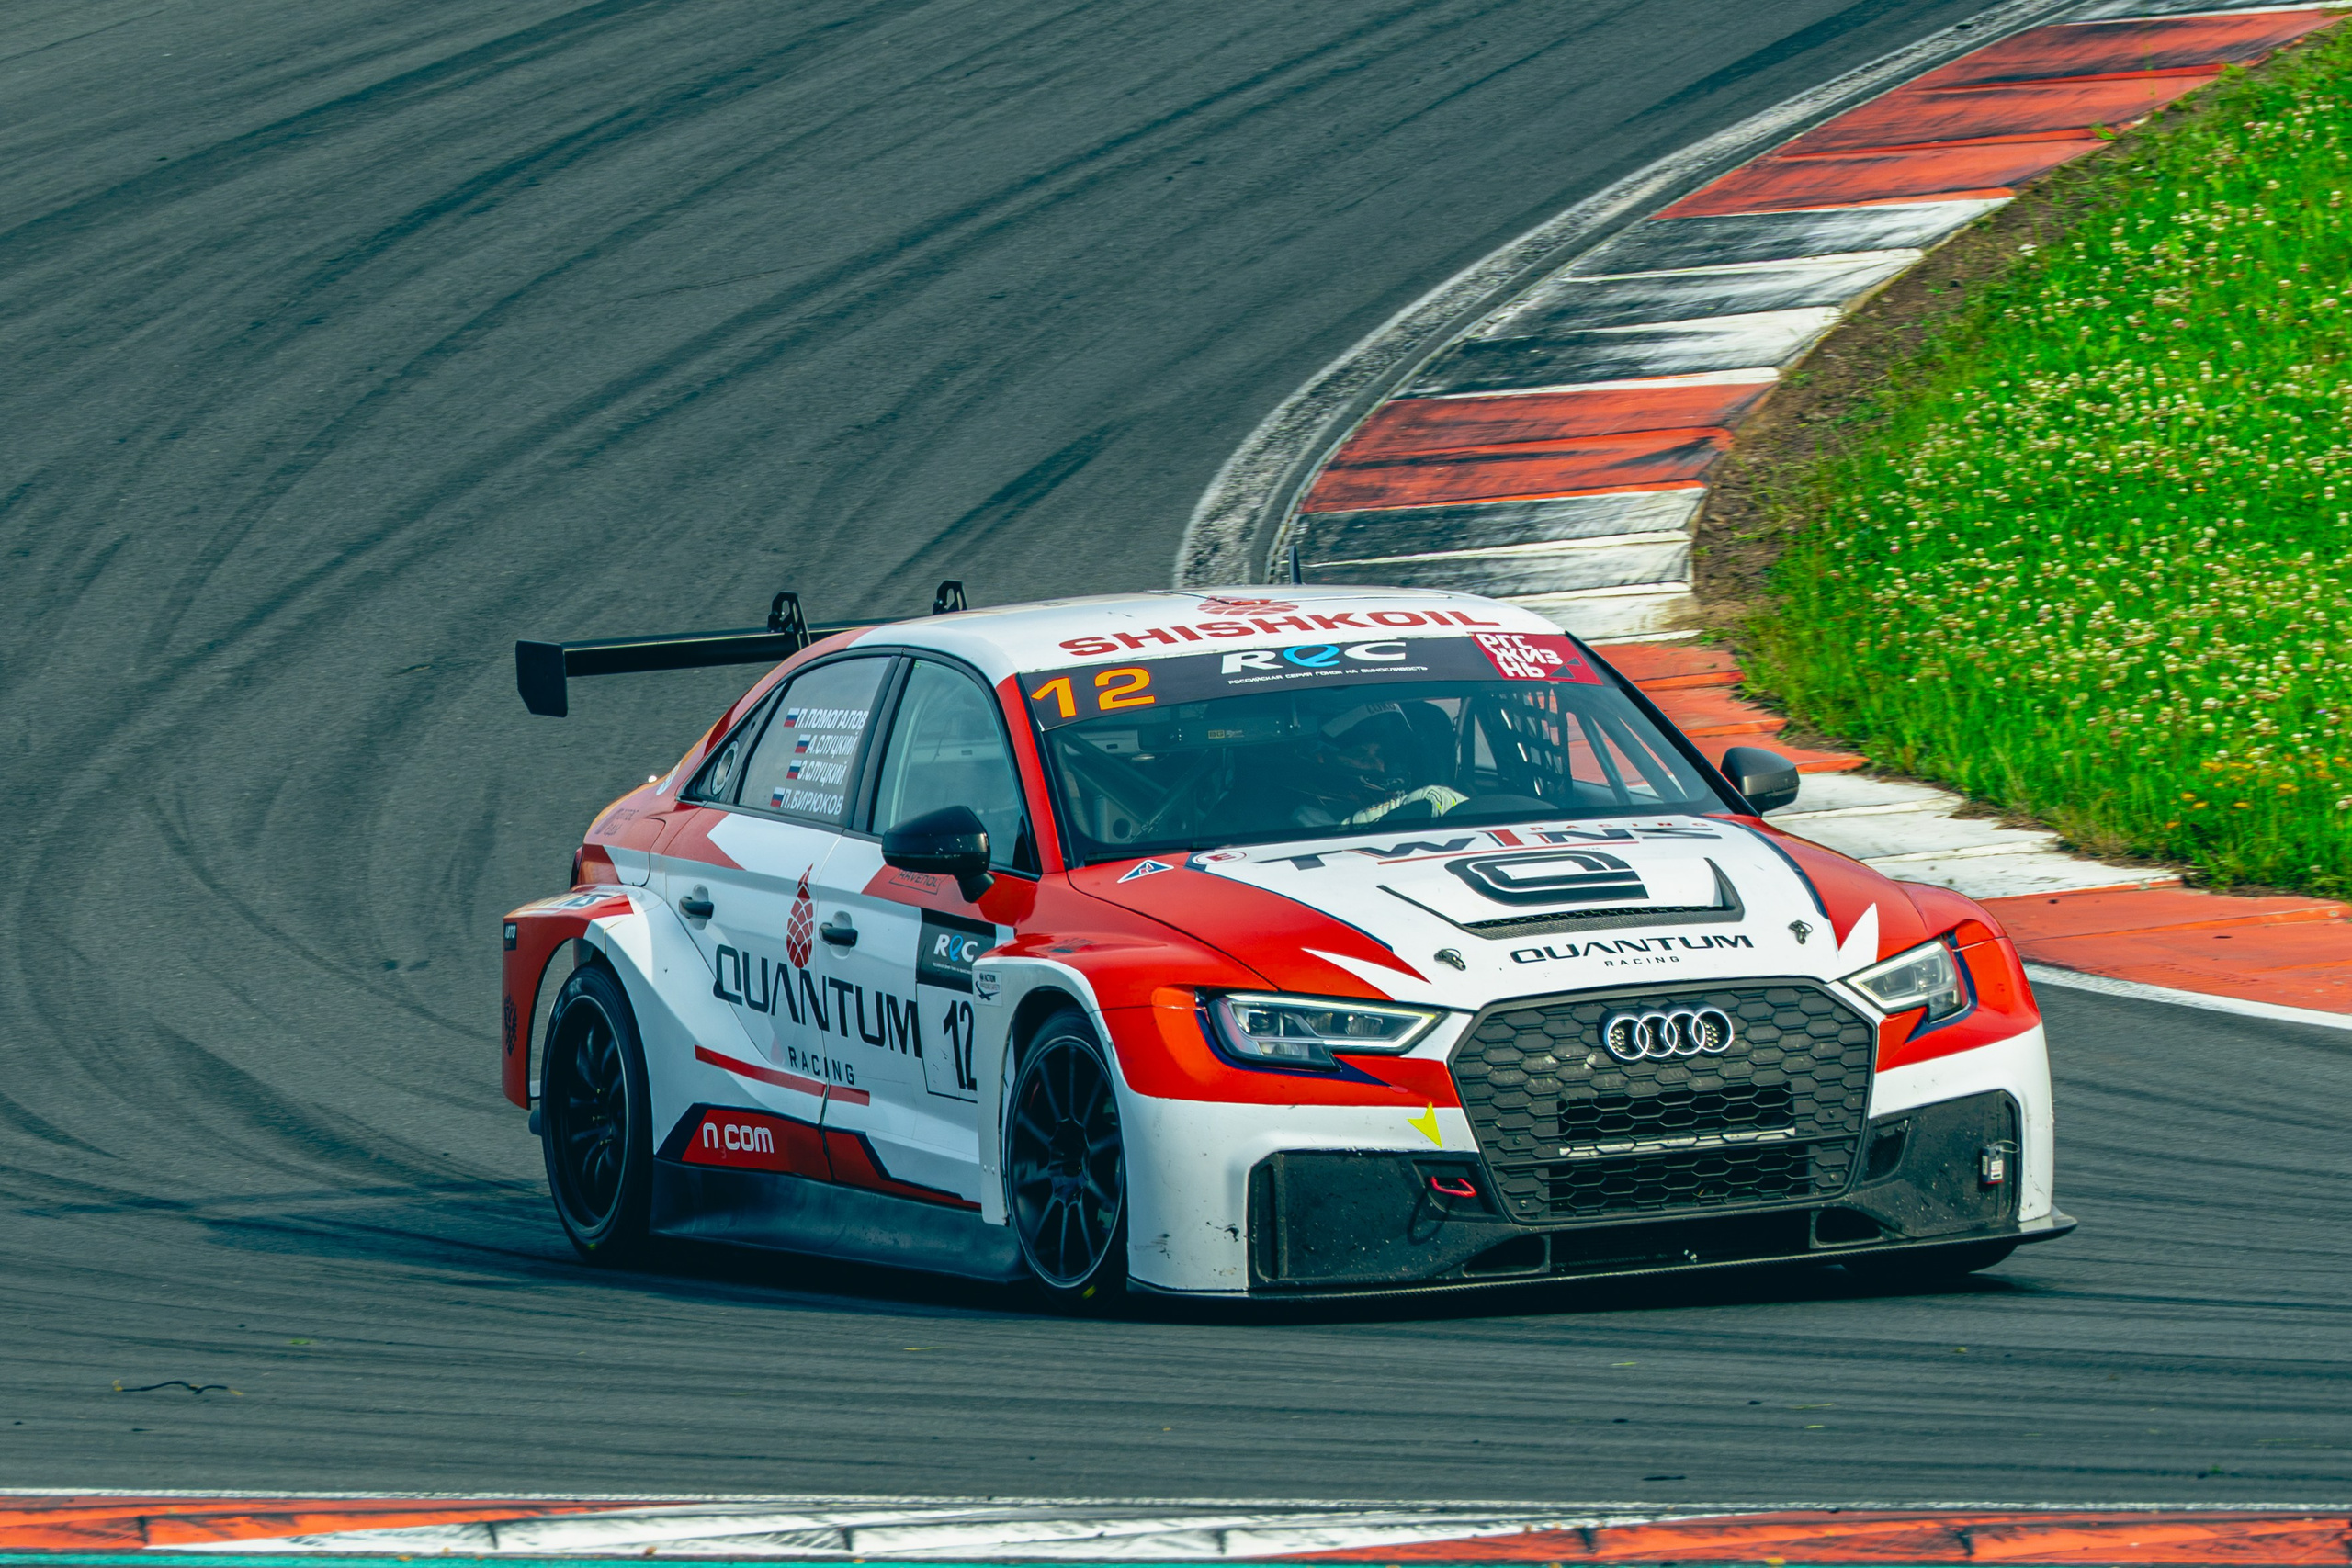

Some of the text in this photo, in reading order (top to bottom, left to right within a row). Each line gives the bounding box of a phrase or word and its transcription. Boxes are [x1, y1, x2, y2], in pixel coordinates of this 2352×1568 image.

[1058, 610, 1500, 656] SHISHKOIL
[1227, 674, 1283, 685] РОССИЙСКАЯ
[1285, 671, 1313, 680] СЕРИЯ
[1361, 665, 1429, 674] ВЫНОСЛИВОСТЬ
[1031, 666, 1156, 718] 12
[794, 708, 869, 730] П.ПОМОГАЛОВ
[805, 731, 859, 759] А.СЛУЦКИЙ
[780, 788, 845, 816] П.БИРЮКОВ
[1510, 935, 1755, 964] QUANTUM
[1604, 955, 1680, 967] RACING
[713, 943, 923, 1060] QUANTUM
[943, 999, 978, 1092] 12
[787, 1045, 855, 1086] RACING
